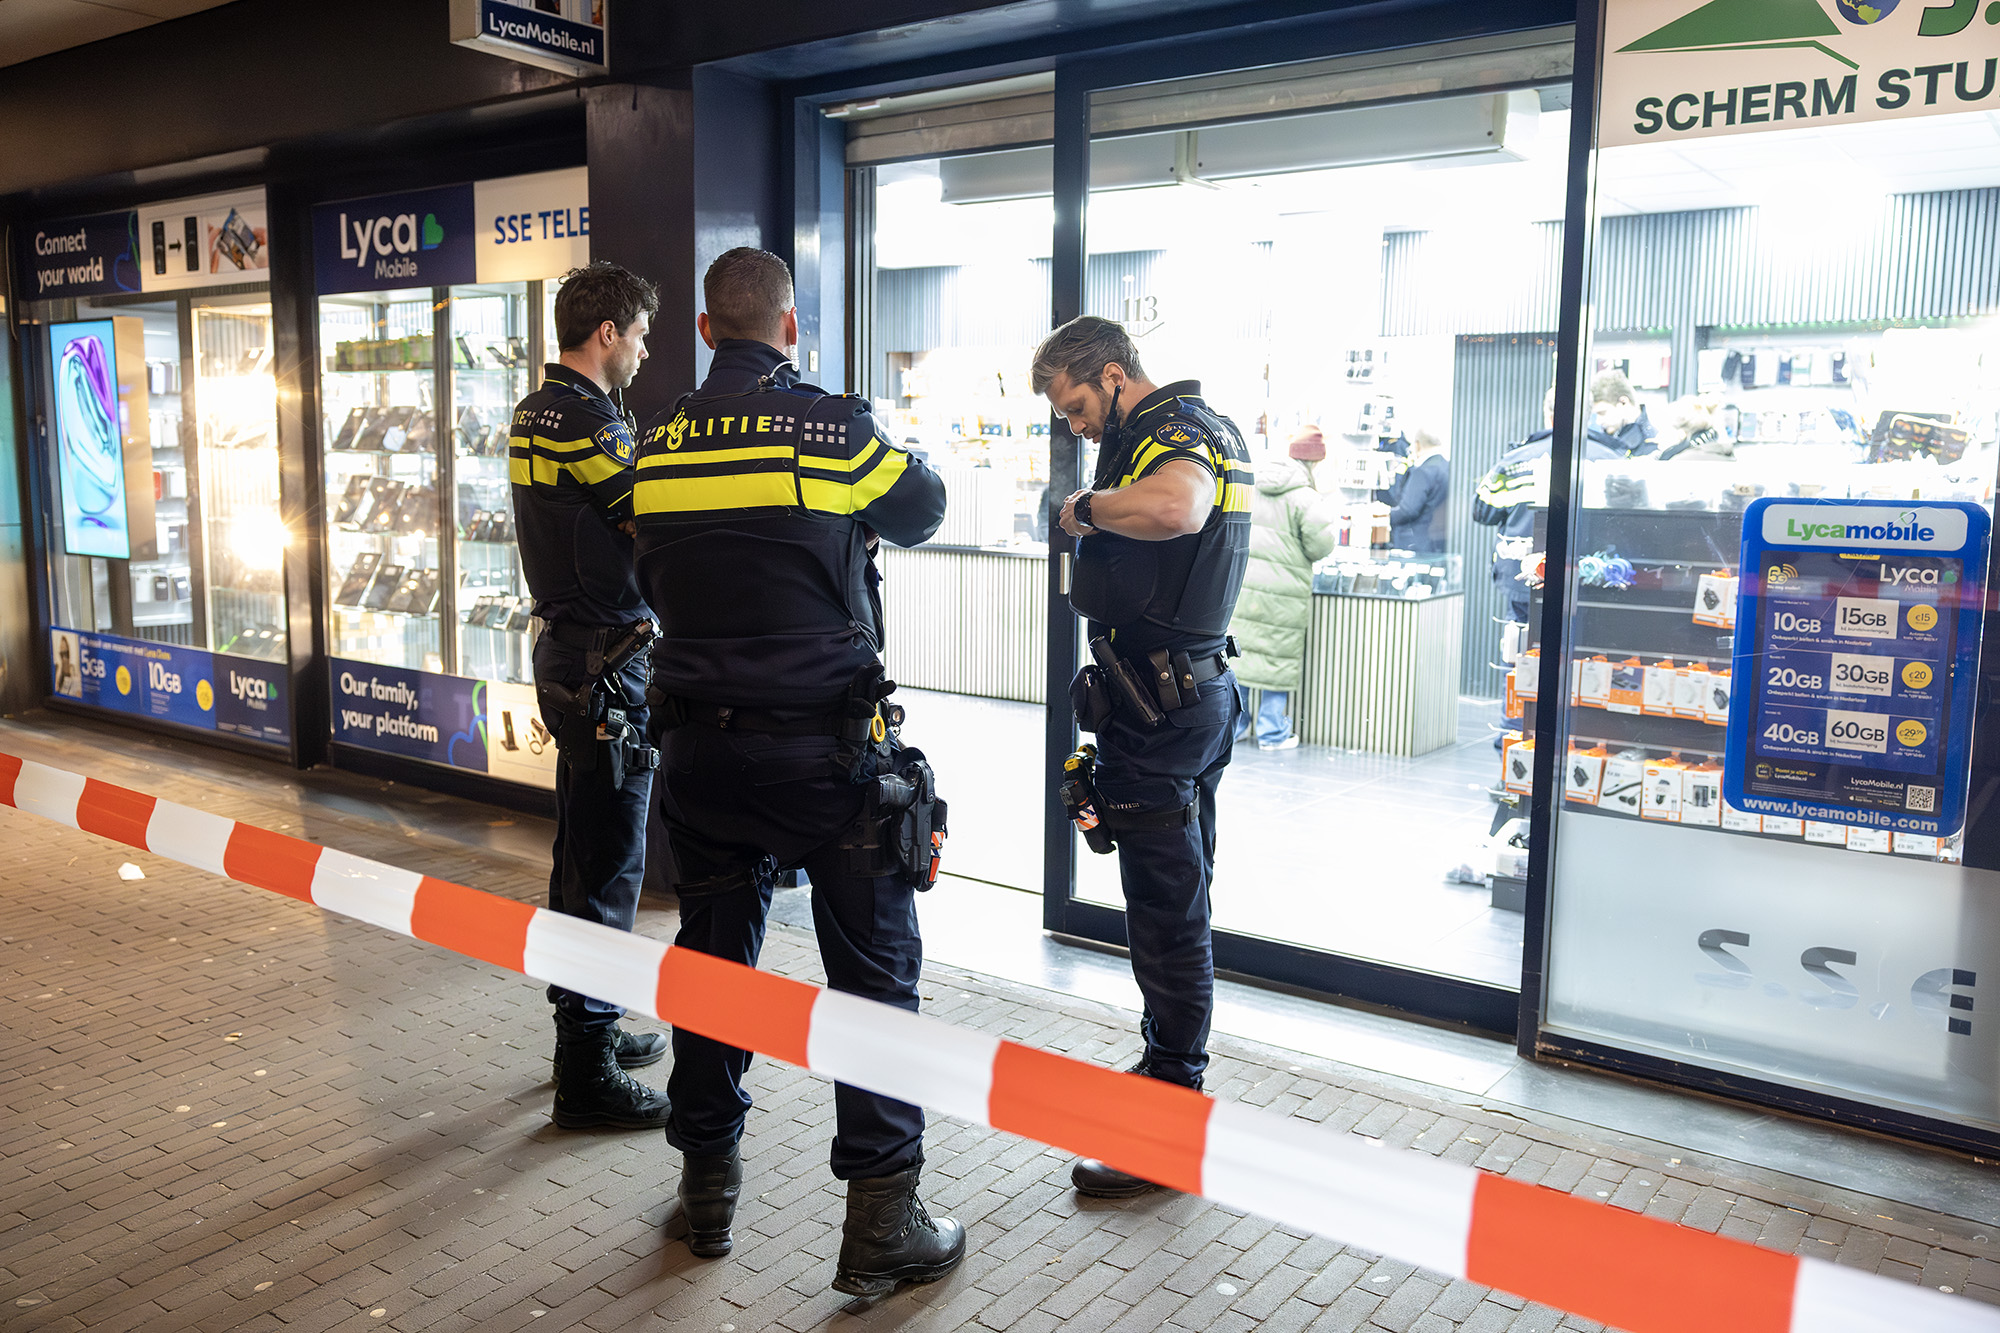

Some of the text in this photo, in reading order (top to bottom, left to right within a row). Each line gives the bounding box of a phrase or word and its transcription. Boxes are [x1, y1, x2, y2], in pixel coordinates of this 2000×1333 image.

[489, 12, 595, 56] LycaMobile.nl
[1633, 73, 1859, 136] SCHERM
[35, 228, 87, 256] Connect
[340, 212, 417, 268] Lyca
[494, 212, 532, 245] SSE
[37, 256, 104, 294] your world
[374, 257, 418, 280] Mobile
[1123, 295, 1158, 322] 113
[653, 406, 773, 451] POLITIE
[1787, 517, 1935, 542] Lycamobile
[1880, 563, 1939, 587] Lyca
[1774, 611, 1822, 633] 10GB
[1842, 607, 1887, 627] 15GB
[81, 649, 107, 679] 5GB
[147, 661, 182, 694] 10GB
[1768, 667, 1823, 690] 20GB
[1835, 663, 1889, 684] 30GB
[230, 670, 267, 700] Lyca
[340, 671, 418, 711] Our family,
[341, 709, 439, 744] your platform
[1763, 723, 1819, 746] 40GB
[1831, 721, 1885, 742] 60GB
[1850, 777, 1904, 790] LycaMobile.nl
[1742, 798, 1938, 832] www.lycamobile.com
